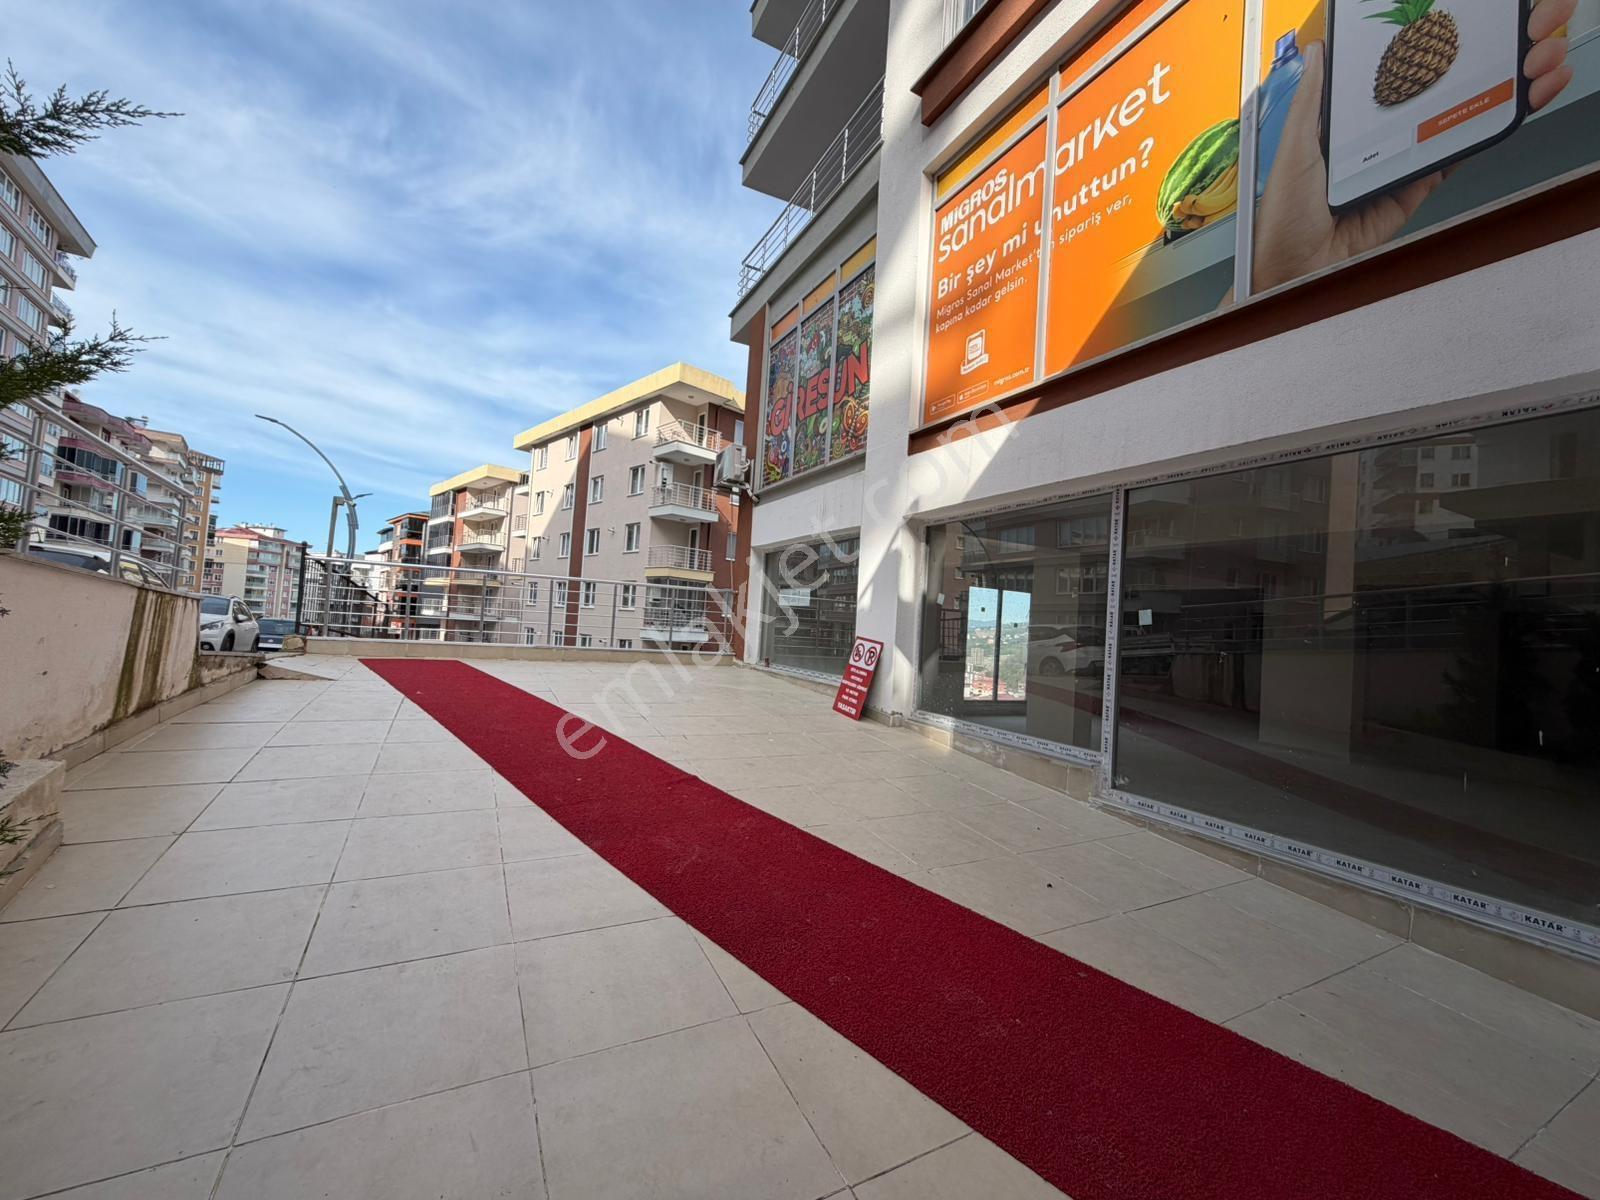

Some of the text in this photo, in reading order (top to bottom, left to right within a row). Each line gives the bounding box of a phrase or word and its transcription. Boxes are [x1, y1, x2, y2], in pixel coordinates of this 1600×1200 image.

[936, 296, 965, 319] Migros
[966, 275, 993, 301] Sanal
[1059, 211, 1101, 245] sipariş
[1106, 193, 1132, 216] ver,
[938, 272, 962, 300] Bir
[966, 248, 997, 286] şey
[1002, 221, 1028, 258] mi
[964, 294, 993, 317] kadar
[994, 275, 1028, 303] gelsin.
[1244, 832, 1266, 844] KATAR
[1287, 844, 1311, 857] KATAR
[1336, 859, 1363, 873] KATAR
[1391, 875, 1421, 890] KATAR
[1453, 894, 1487, 910] KATAR
[1524, 914, 1564, 933] KATAR
